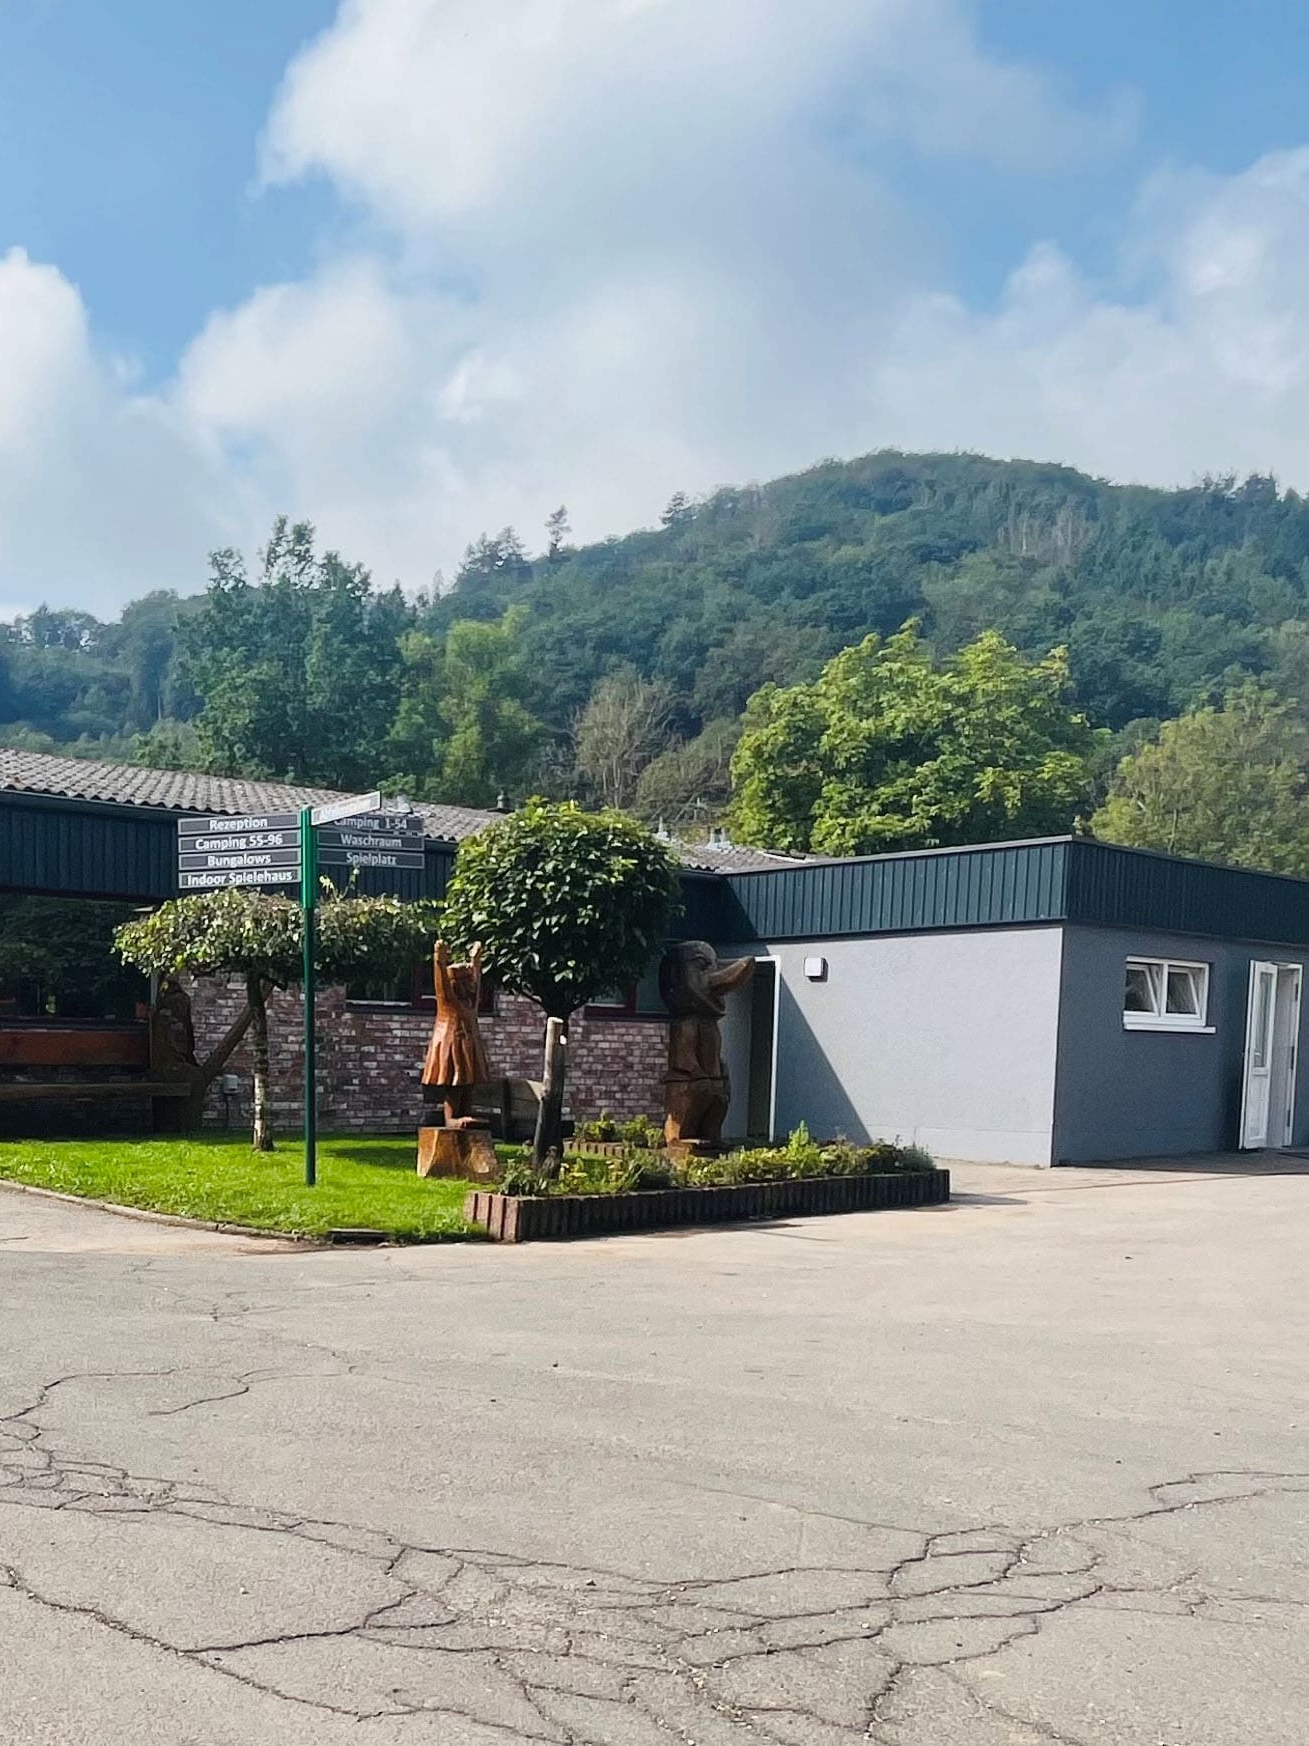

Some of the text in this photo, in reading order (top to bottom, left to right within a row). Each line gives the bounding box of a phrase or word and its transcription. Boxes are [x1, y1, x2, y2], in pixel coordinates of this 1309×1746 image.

[209, 817, 268, 831] Rezeption
[385, 817, 408, 830] 1-54
[195, 833, 283, 850] Camping 55-96
[340, 833, 402, 848] Waschraum
[207, 853, 271, 868] Bungalows
[346, 851, 397, 866] Spielplatz
[187, 869, 293, 886] Indoor Spielehaus
